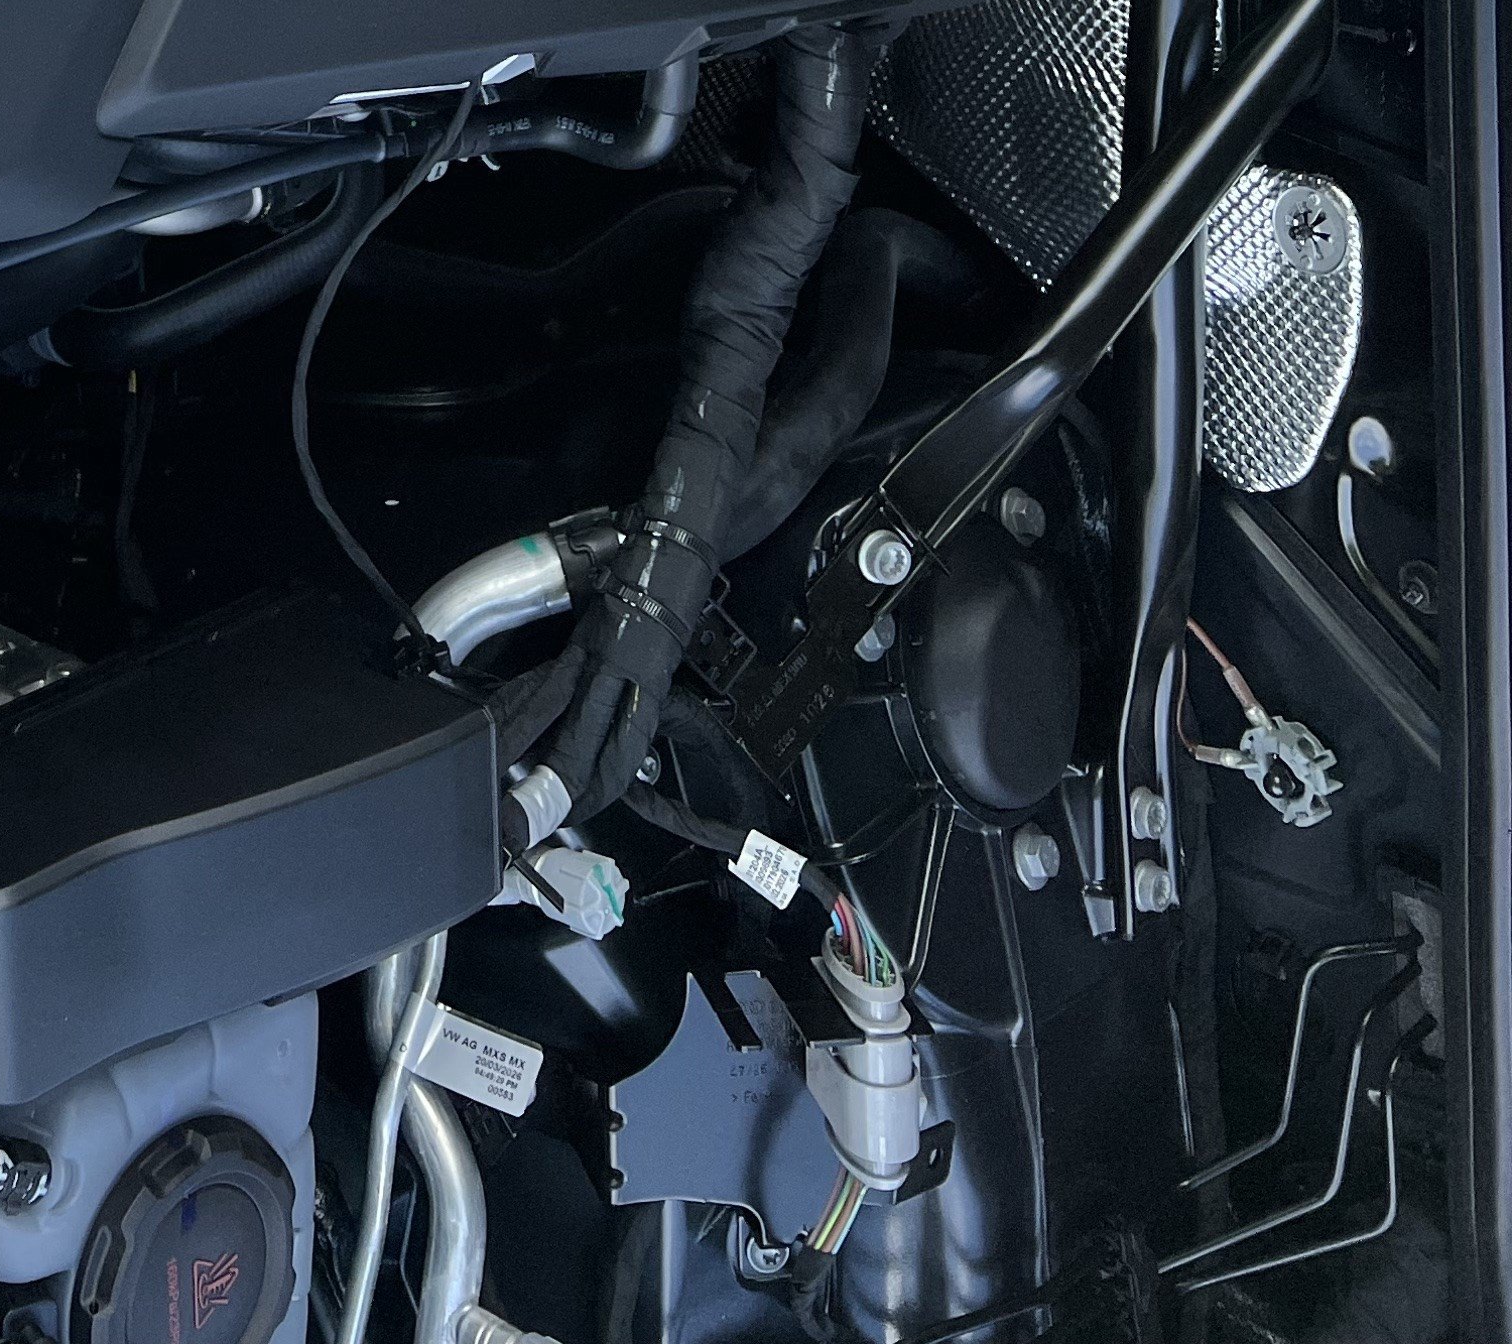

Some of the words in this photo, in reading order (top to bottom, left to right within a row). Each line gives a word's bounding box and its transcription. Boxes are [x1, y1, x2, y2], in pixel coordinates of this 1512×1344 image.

[443, 1028, 461, 1043] VW
[461, 1037, 478, 1050] AG
[482, 1045, 507, 1063] MXS
[508, 1055, 526, 1071] MX
[505, 1079, 519, 1090] PM
